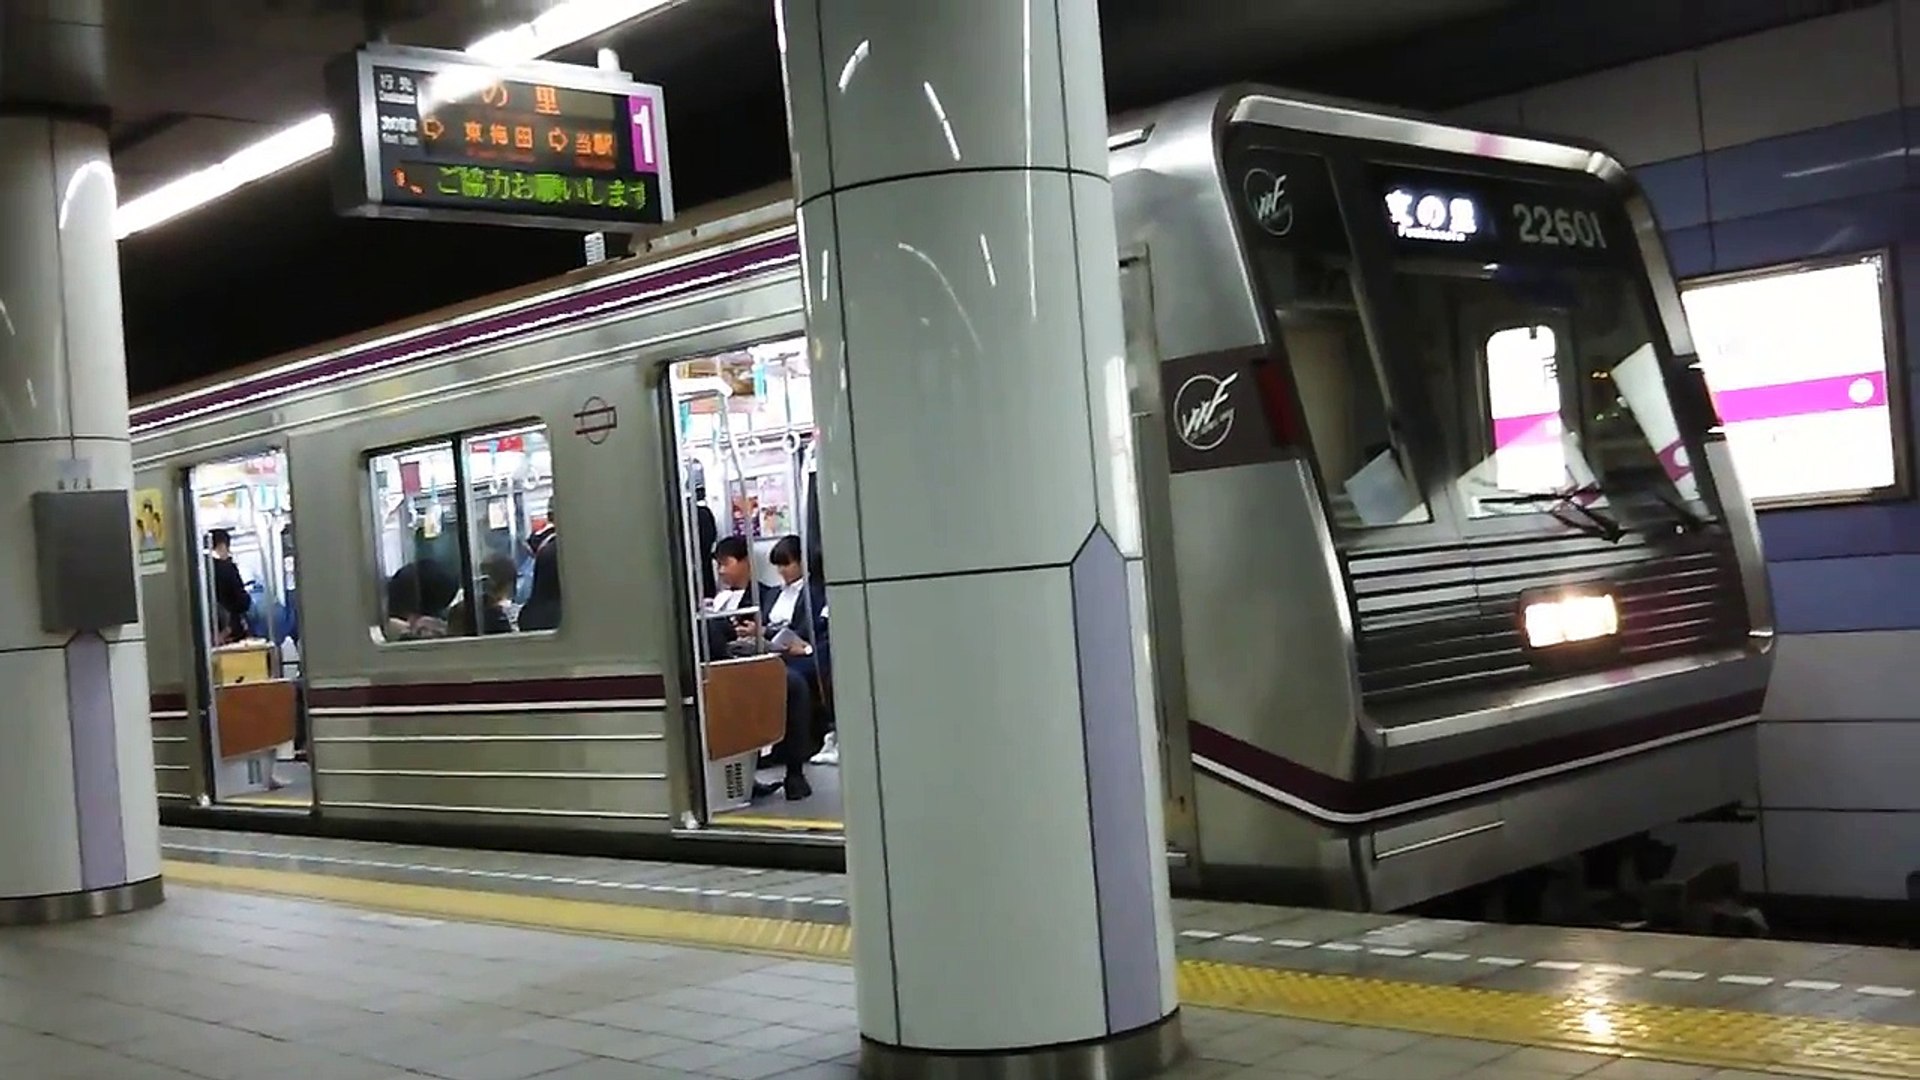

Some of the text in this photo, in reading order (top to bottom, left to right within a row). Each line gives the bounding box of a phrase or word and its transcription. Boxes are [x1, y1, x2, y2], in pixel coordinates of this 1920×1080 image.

[464, 120, 615, 156] 東梅田 当駅
[632, 104, 654, 164] 1
[438, 166, 646, 209] ご協力お願いします
[1512, 202, 1608, 250] 22601
